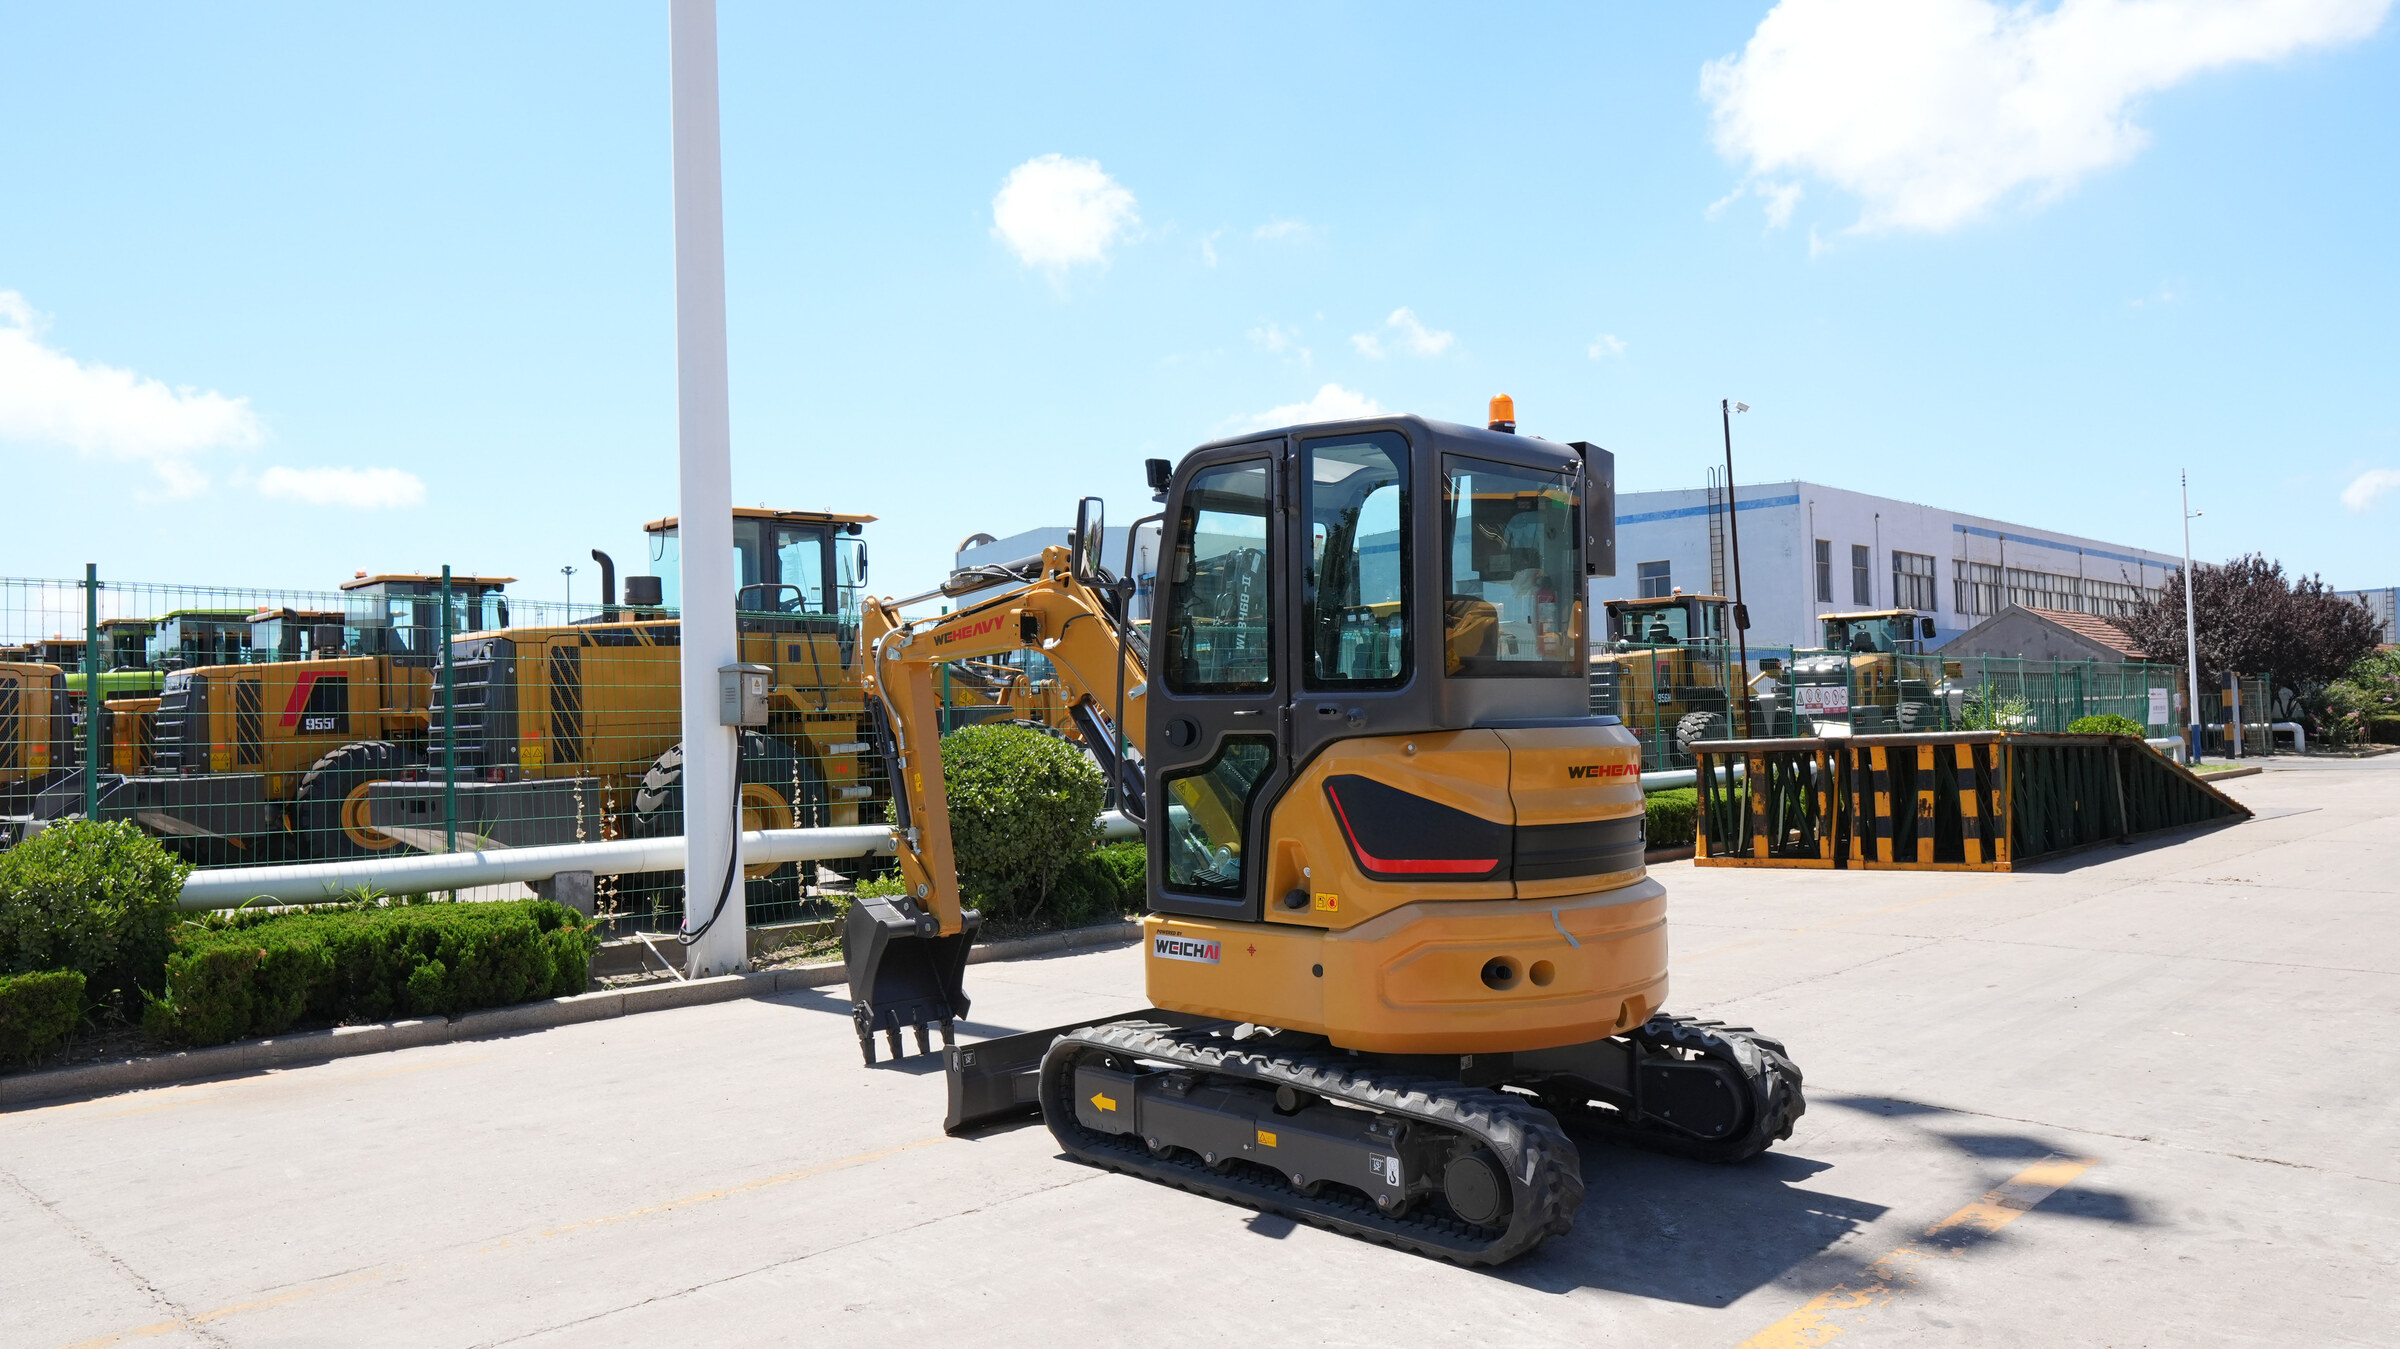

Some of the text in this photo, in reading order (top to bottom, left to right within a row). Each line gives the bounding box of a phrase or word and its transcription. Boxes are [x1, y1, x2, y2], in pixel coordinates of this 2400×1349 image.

[933, 614, 1006, 646] WEHEAVY
[1156, 928, 1177, 936] POWERED
[1156, 939, 1220, 960] WEICHAI
